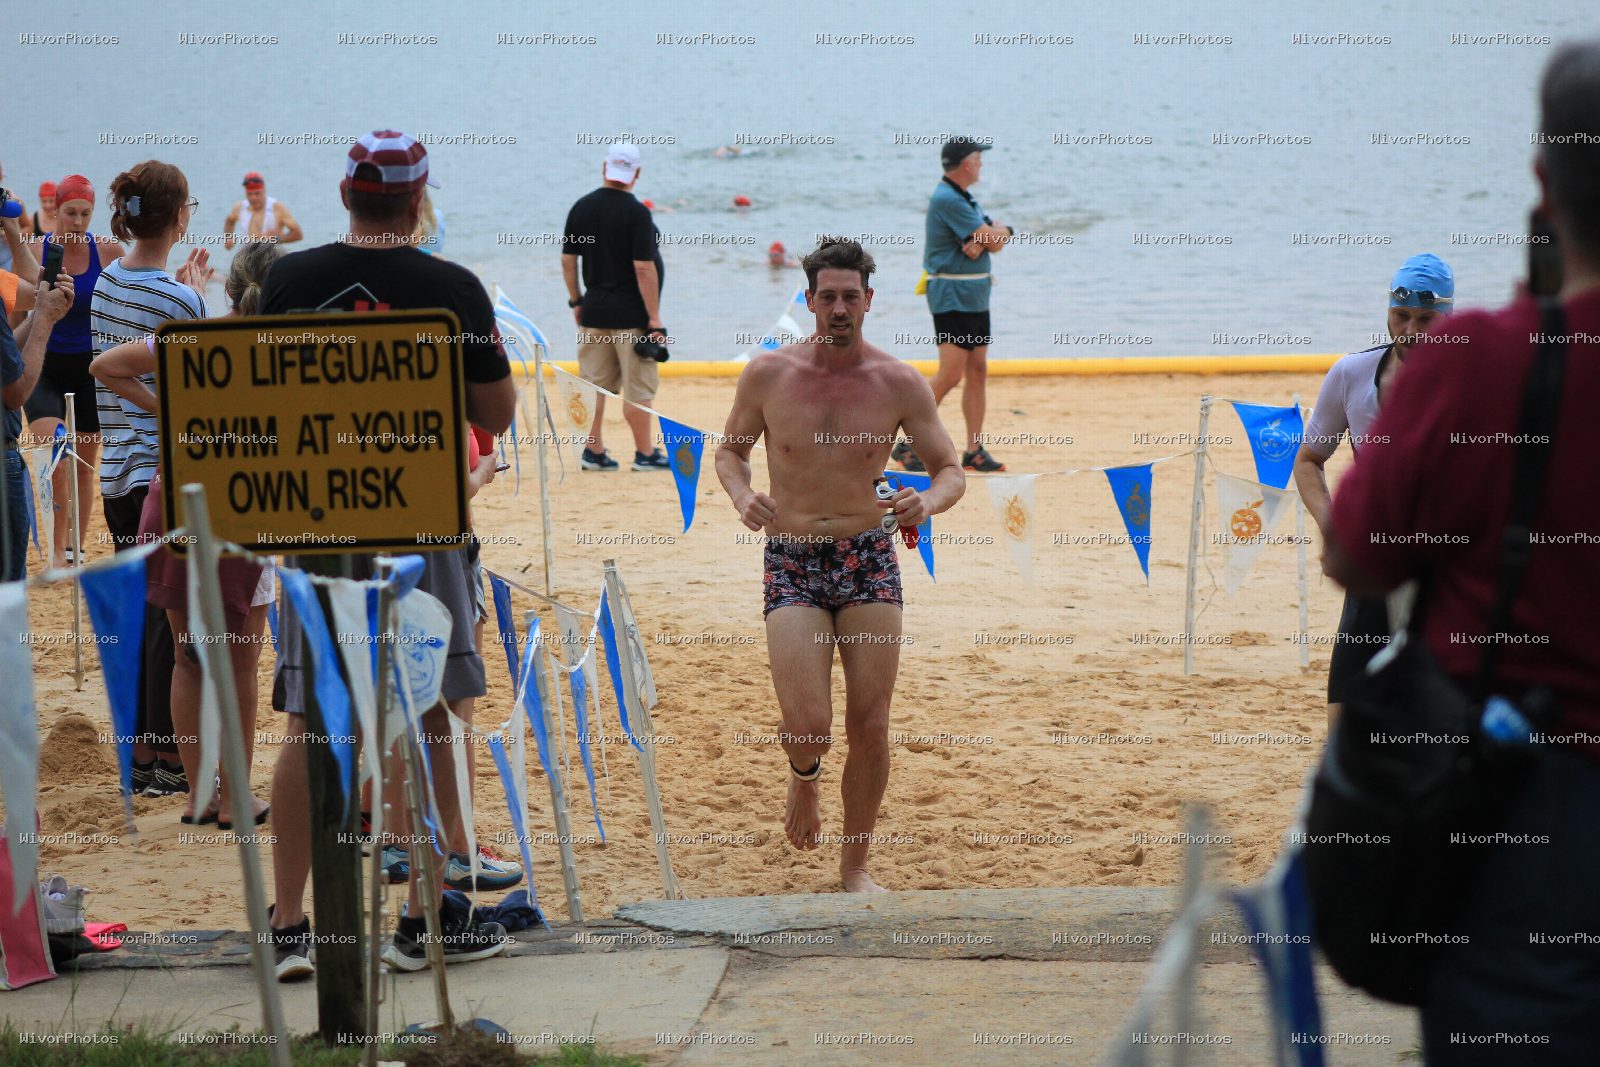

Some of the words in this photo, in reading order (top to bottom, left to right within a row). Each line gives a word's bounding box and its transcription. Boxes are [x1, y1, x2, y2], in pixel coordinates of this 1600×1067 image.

[183, 347, 232, 388] NO
[251, 340, 438, 385] LIFEGUARD
[186, 417, 278, 460] SWIM
[297, 414, 334, 455] AT
[353, 411, 444, 453] YOUR
[229, 471, 309, 513] OWN
[329, 468, 407, 509] RISK
